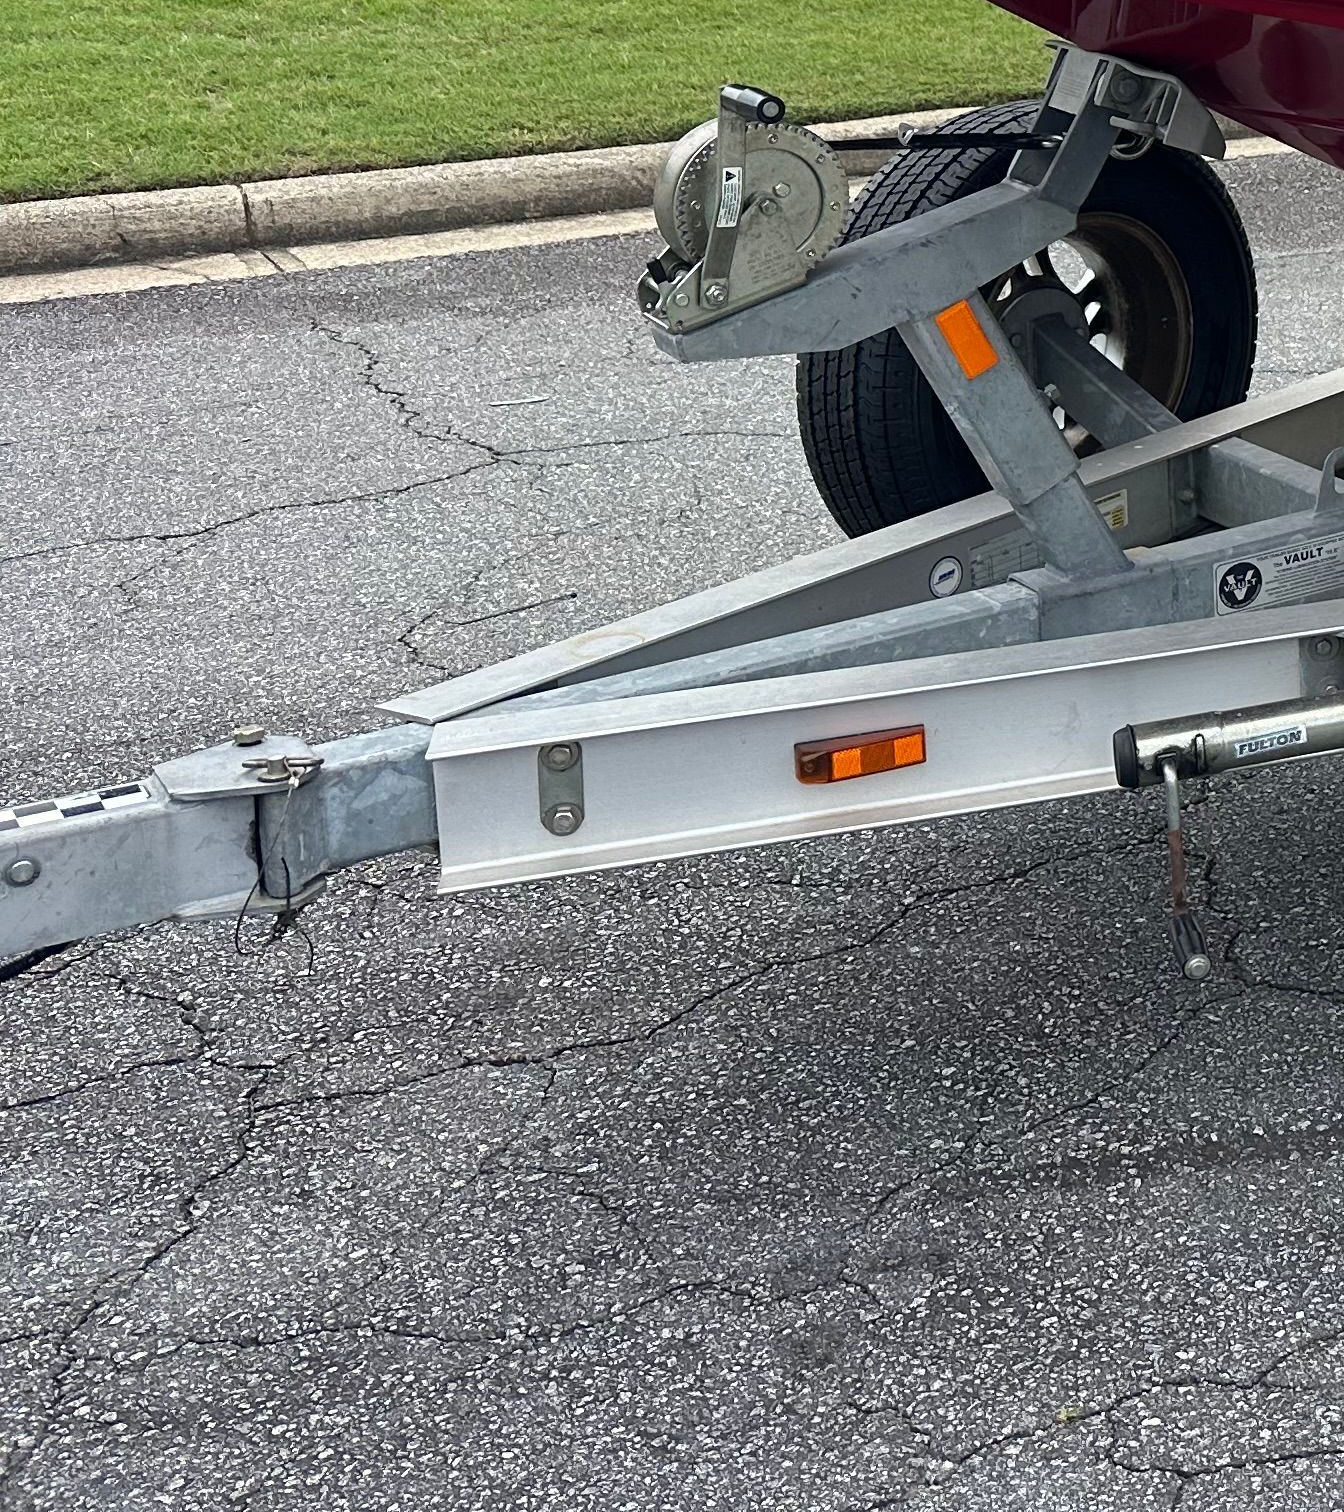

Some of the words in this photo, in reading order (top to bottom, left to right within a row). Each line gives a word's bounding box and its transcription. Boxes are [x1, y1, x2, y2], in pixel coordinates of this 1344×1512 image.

[1283, 546, 1324, 566] VAULT
[1223, 577, 1258, 593] VAULT
[1238, 730, 1302, 756] FULTON
